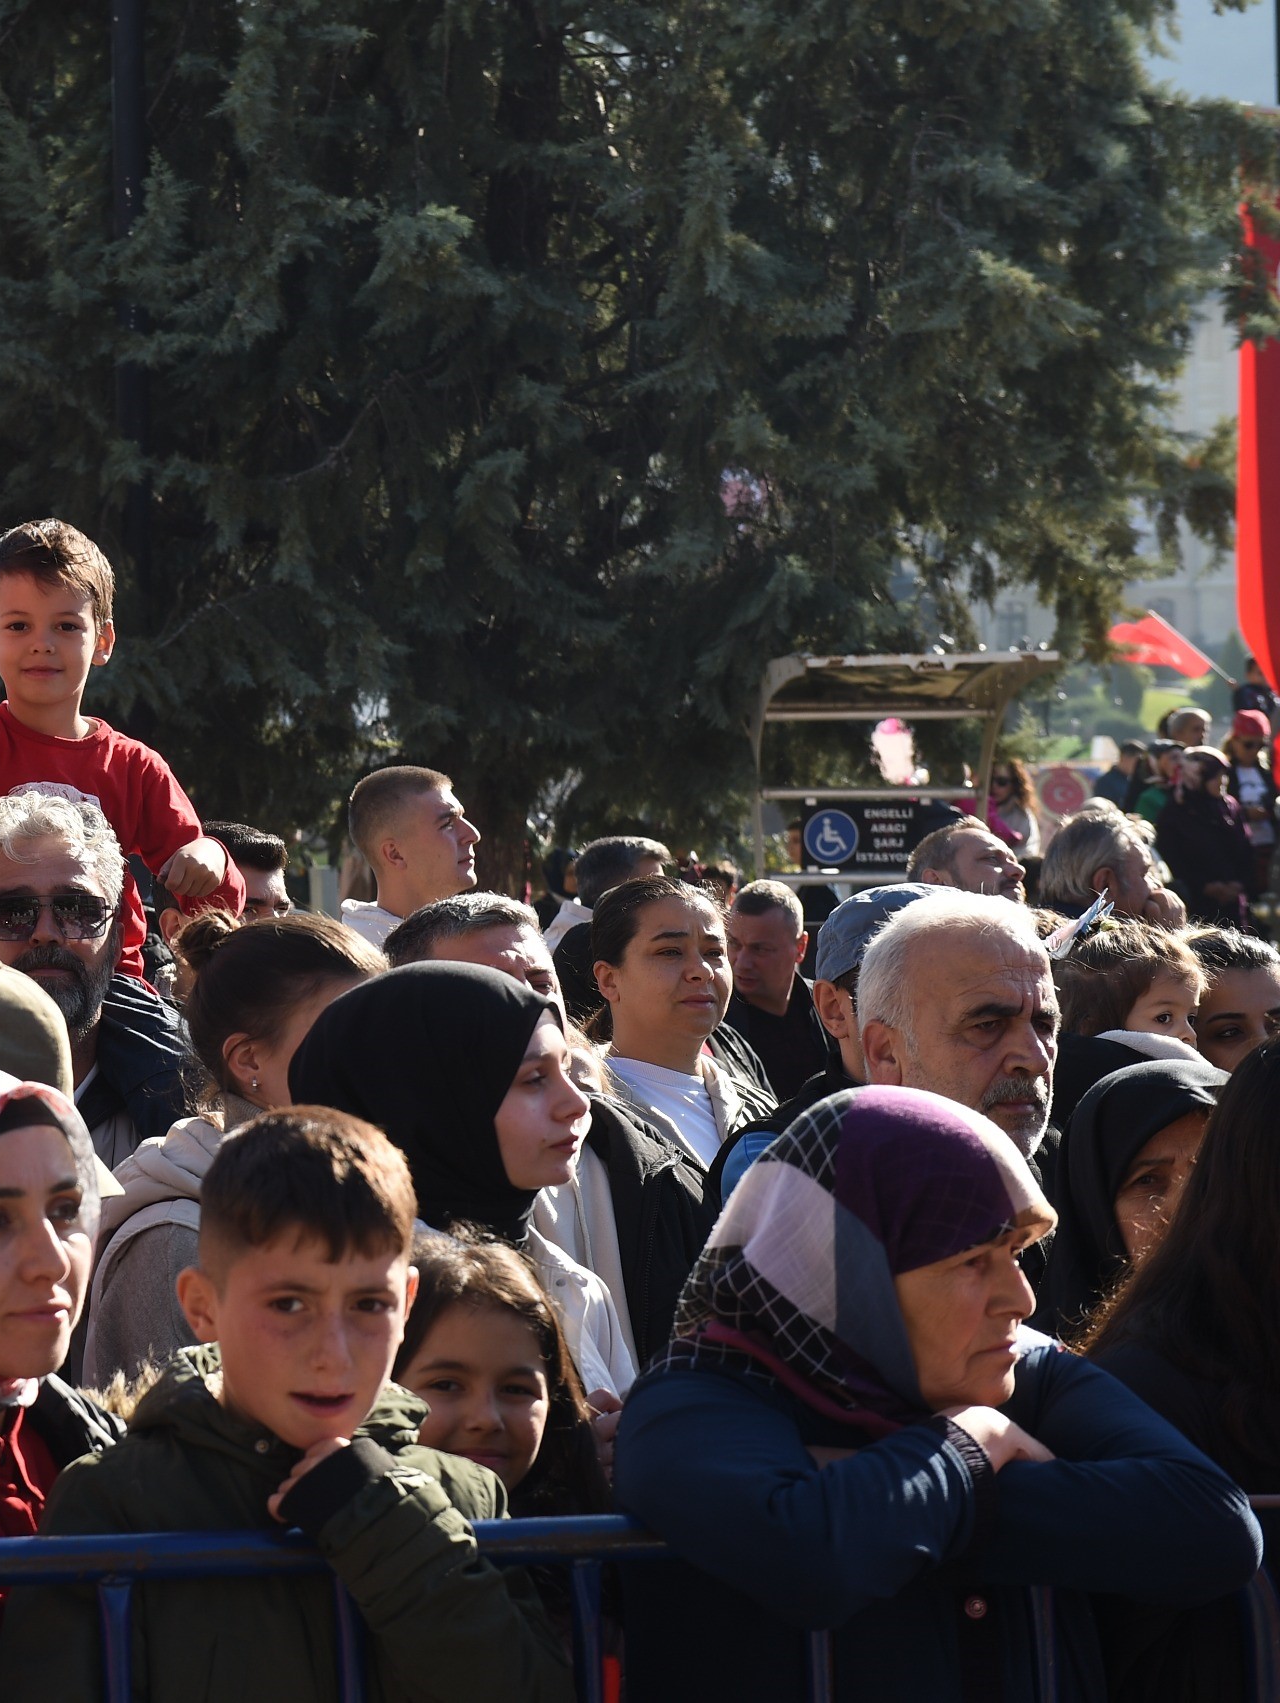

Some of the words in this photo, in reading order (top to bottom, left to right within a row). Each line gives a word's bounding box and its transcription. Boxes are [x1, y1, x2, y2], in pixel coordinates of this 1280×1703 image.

[864, 807, 913, 819] ENGELLİ
[870, 823, 907, 833] ARACI
[873, 837, 904, 849] ŞARJ
